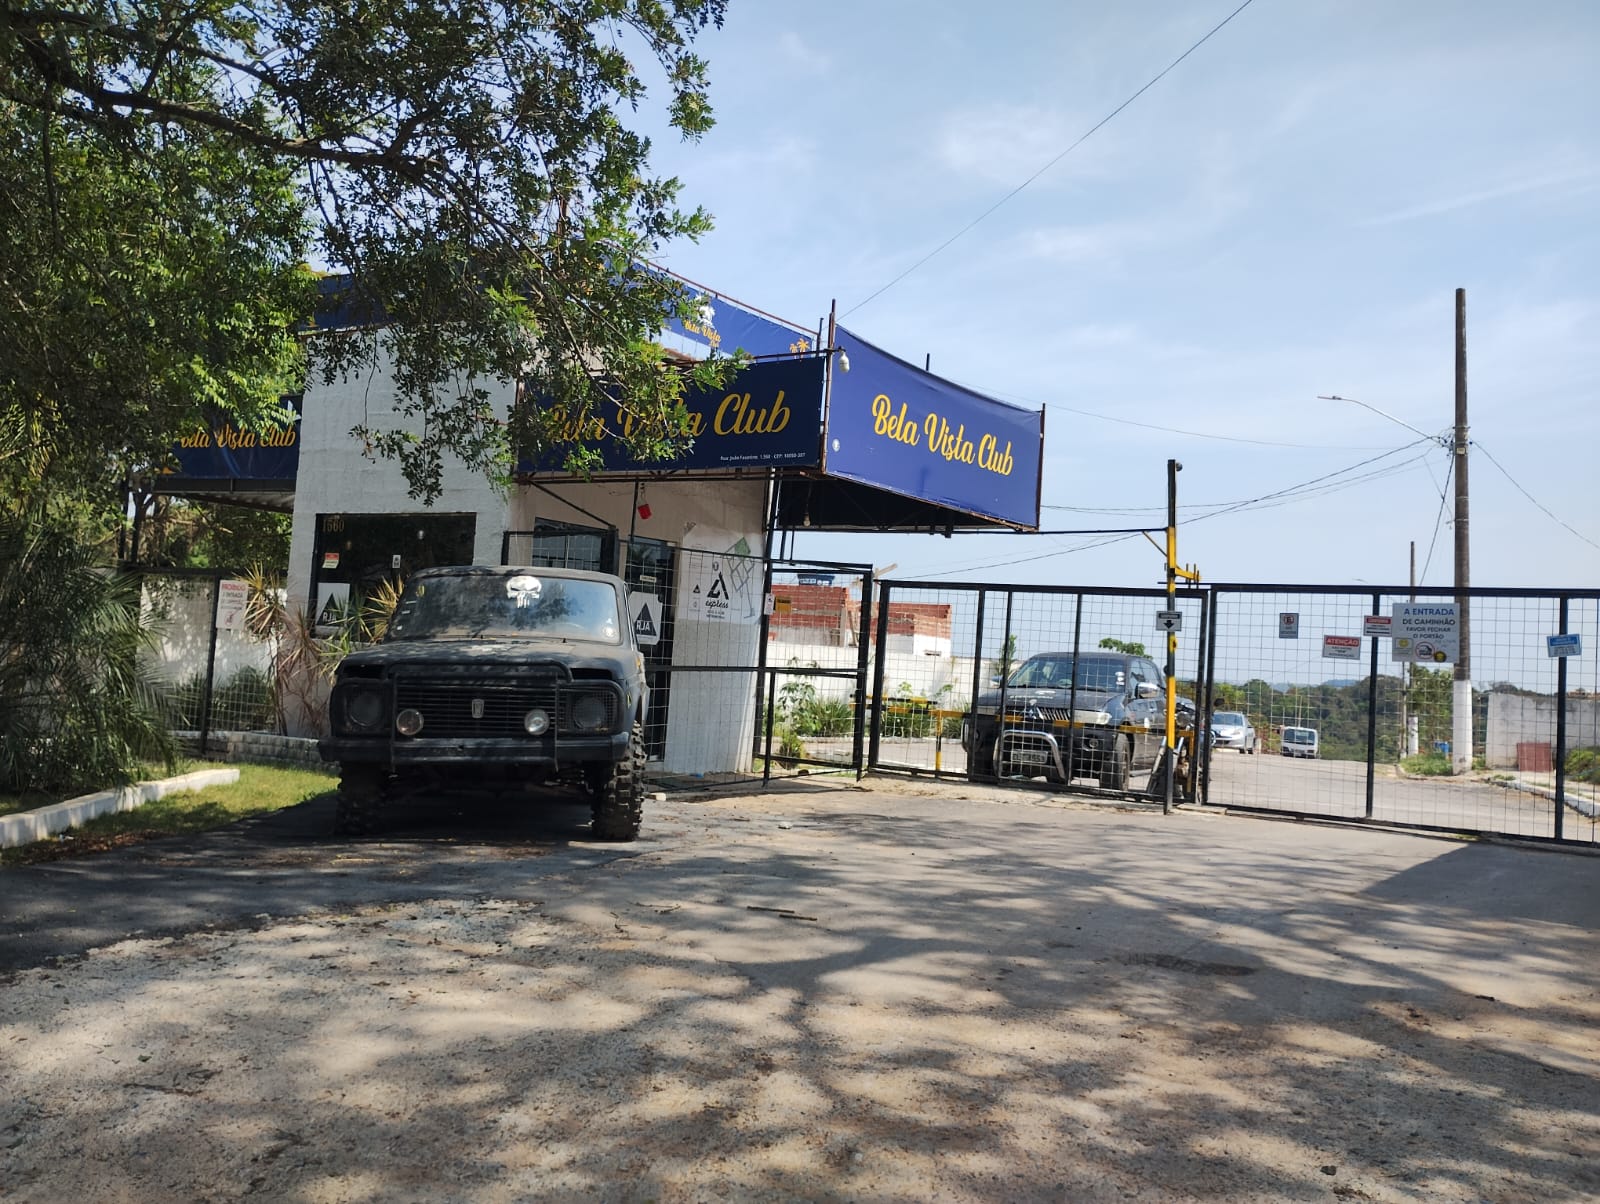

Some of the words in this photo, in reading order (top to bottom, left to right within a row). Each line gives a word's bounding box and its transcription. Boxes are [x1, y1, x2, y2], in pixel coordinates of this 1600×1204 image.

[713, 390, 791, 436] Club
[213, 423, 258, 450] Vista
[871, 394, 920, 446] Bela
[924, 412, 976, 465] Vista
[977, 433, 1014, 476] Club
[1412, 608, 1454, 616] ENTRADA
[636, 620, 651, 631] RJA
[1414, 617, 1456, 625] CAMINHÃO
[1327, 638, 1359, 646] ATENÇÃO
